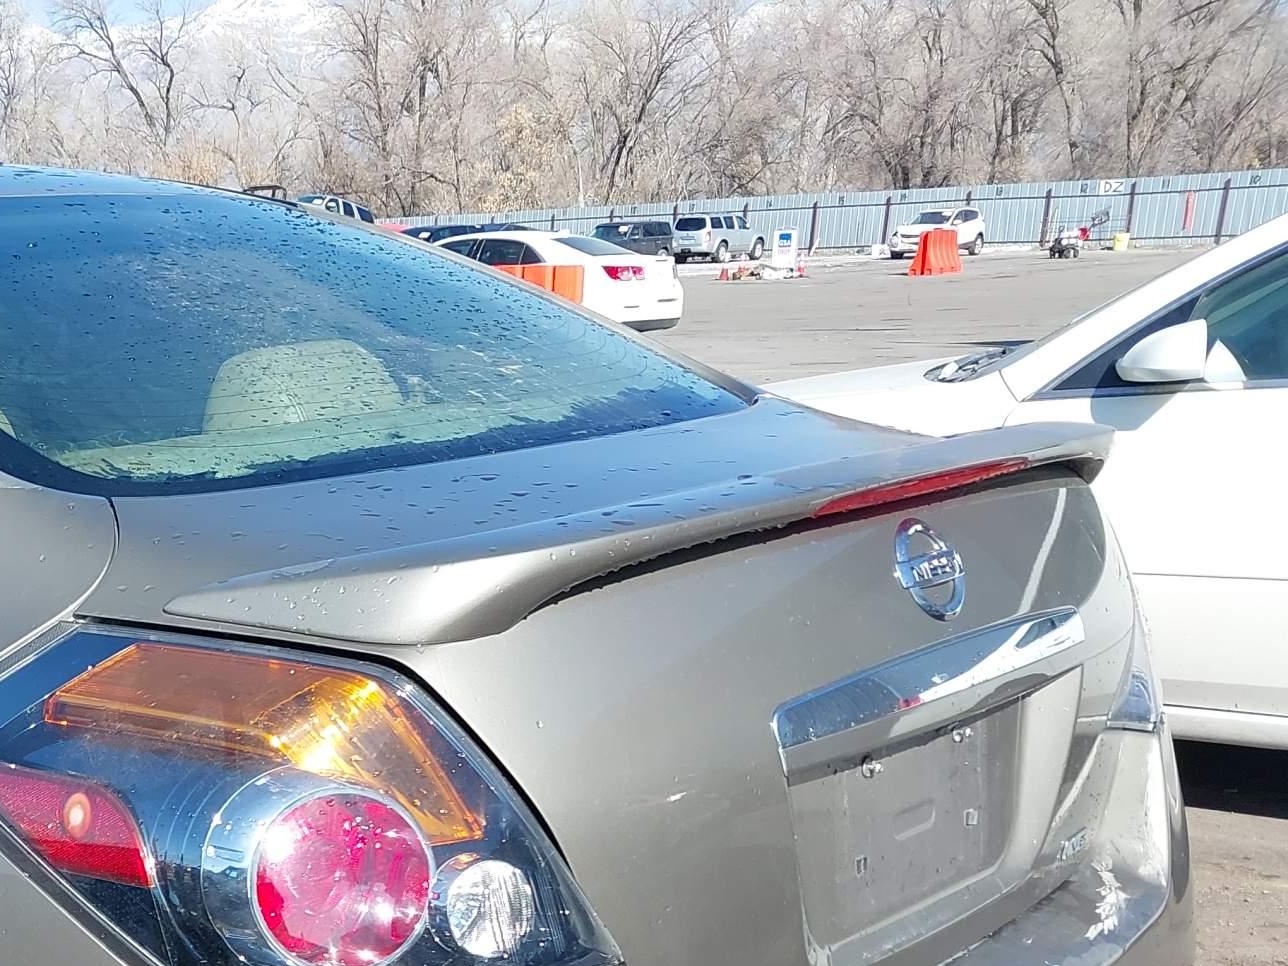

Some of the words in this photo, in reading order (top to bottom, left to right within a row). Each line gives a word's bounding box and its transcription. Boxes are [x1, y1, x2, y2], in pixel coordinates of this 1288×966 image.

[1162, 178, 1170, 189] 11
[1249, 175, 1261, 185] 10
[1080, 183, 1088, 193] 12
